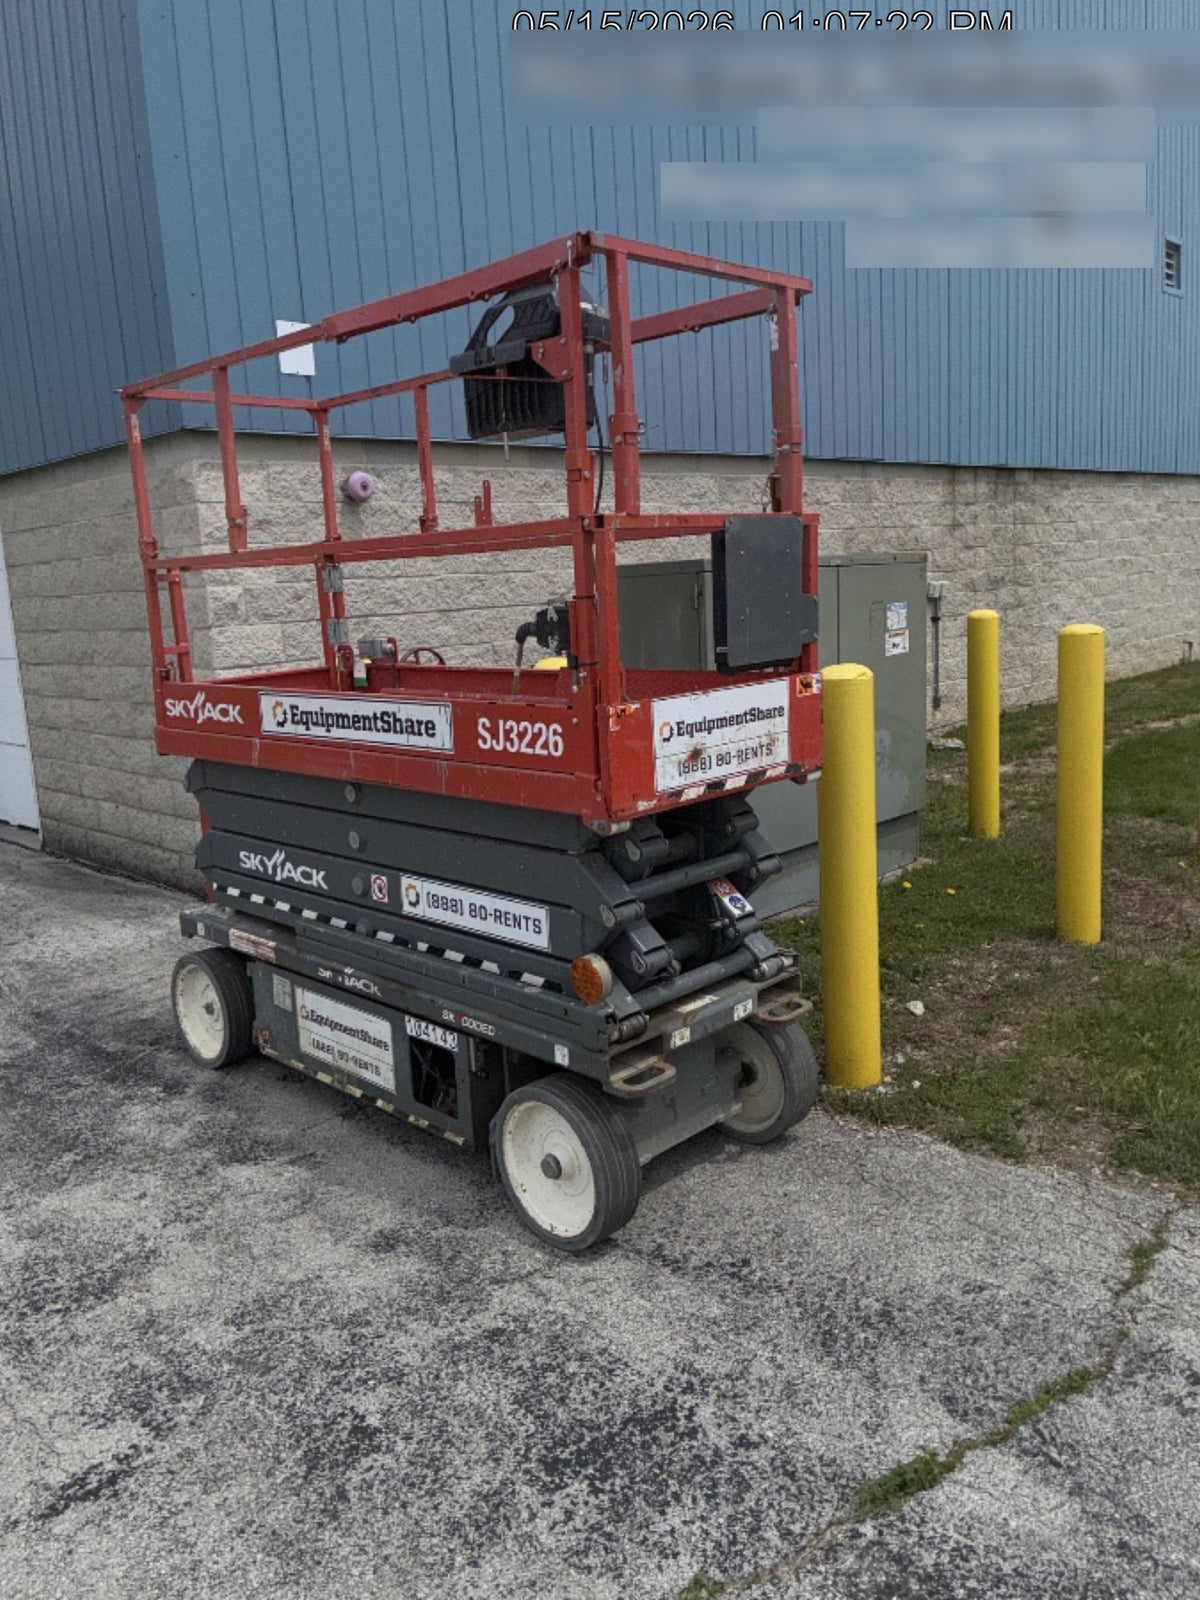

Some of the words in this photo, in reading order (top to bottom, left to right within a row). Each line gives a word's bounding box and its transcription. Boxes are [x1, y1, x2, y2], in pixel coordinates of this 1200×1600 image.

[165, 690, 243, 725] SKYJACK
[289, 703, 436, 738] EquipmentShare
[675, 705, 785, 739] EquipmentShare
[477, 716, 564, 757] SJ3226
[716, 742, 773, 768] 80-RENTS
[239, 849, 329, 890] SKYJACK
[426, 890, 464, 915] (888)
[468, 902, 543, 935] 80-RENTS
[317, 966, 382, 998] SJACK
[311, 1009, 390, 1052] EquipmentShare
[442, 1009, 497, 1036] SKCODED
